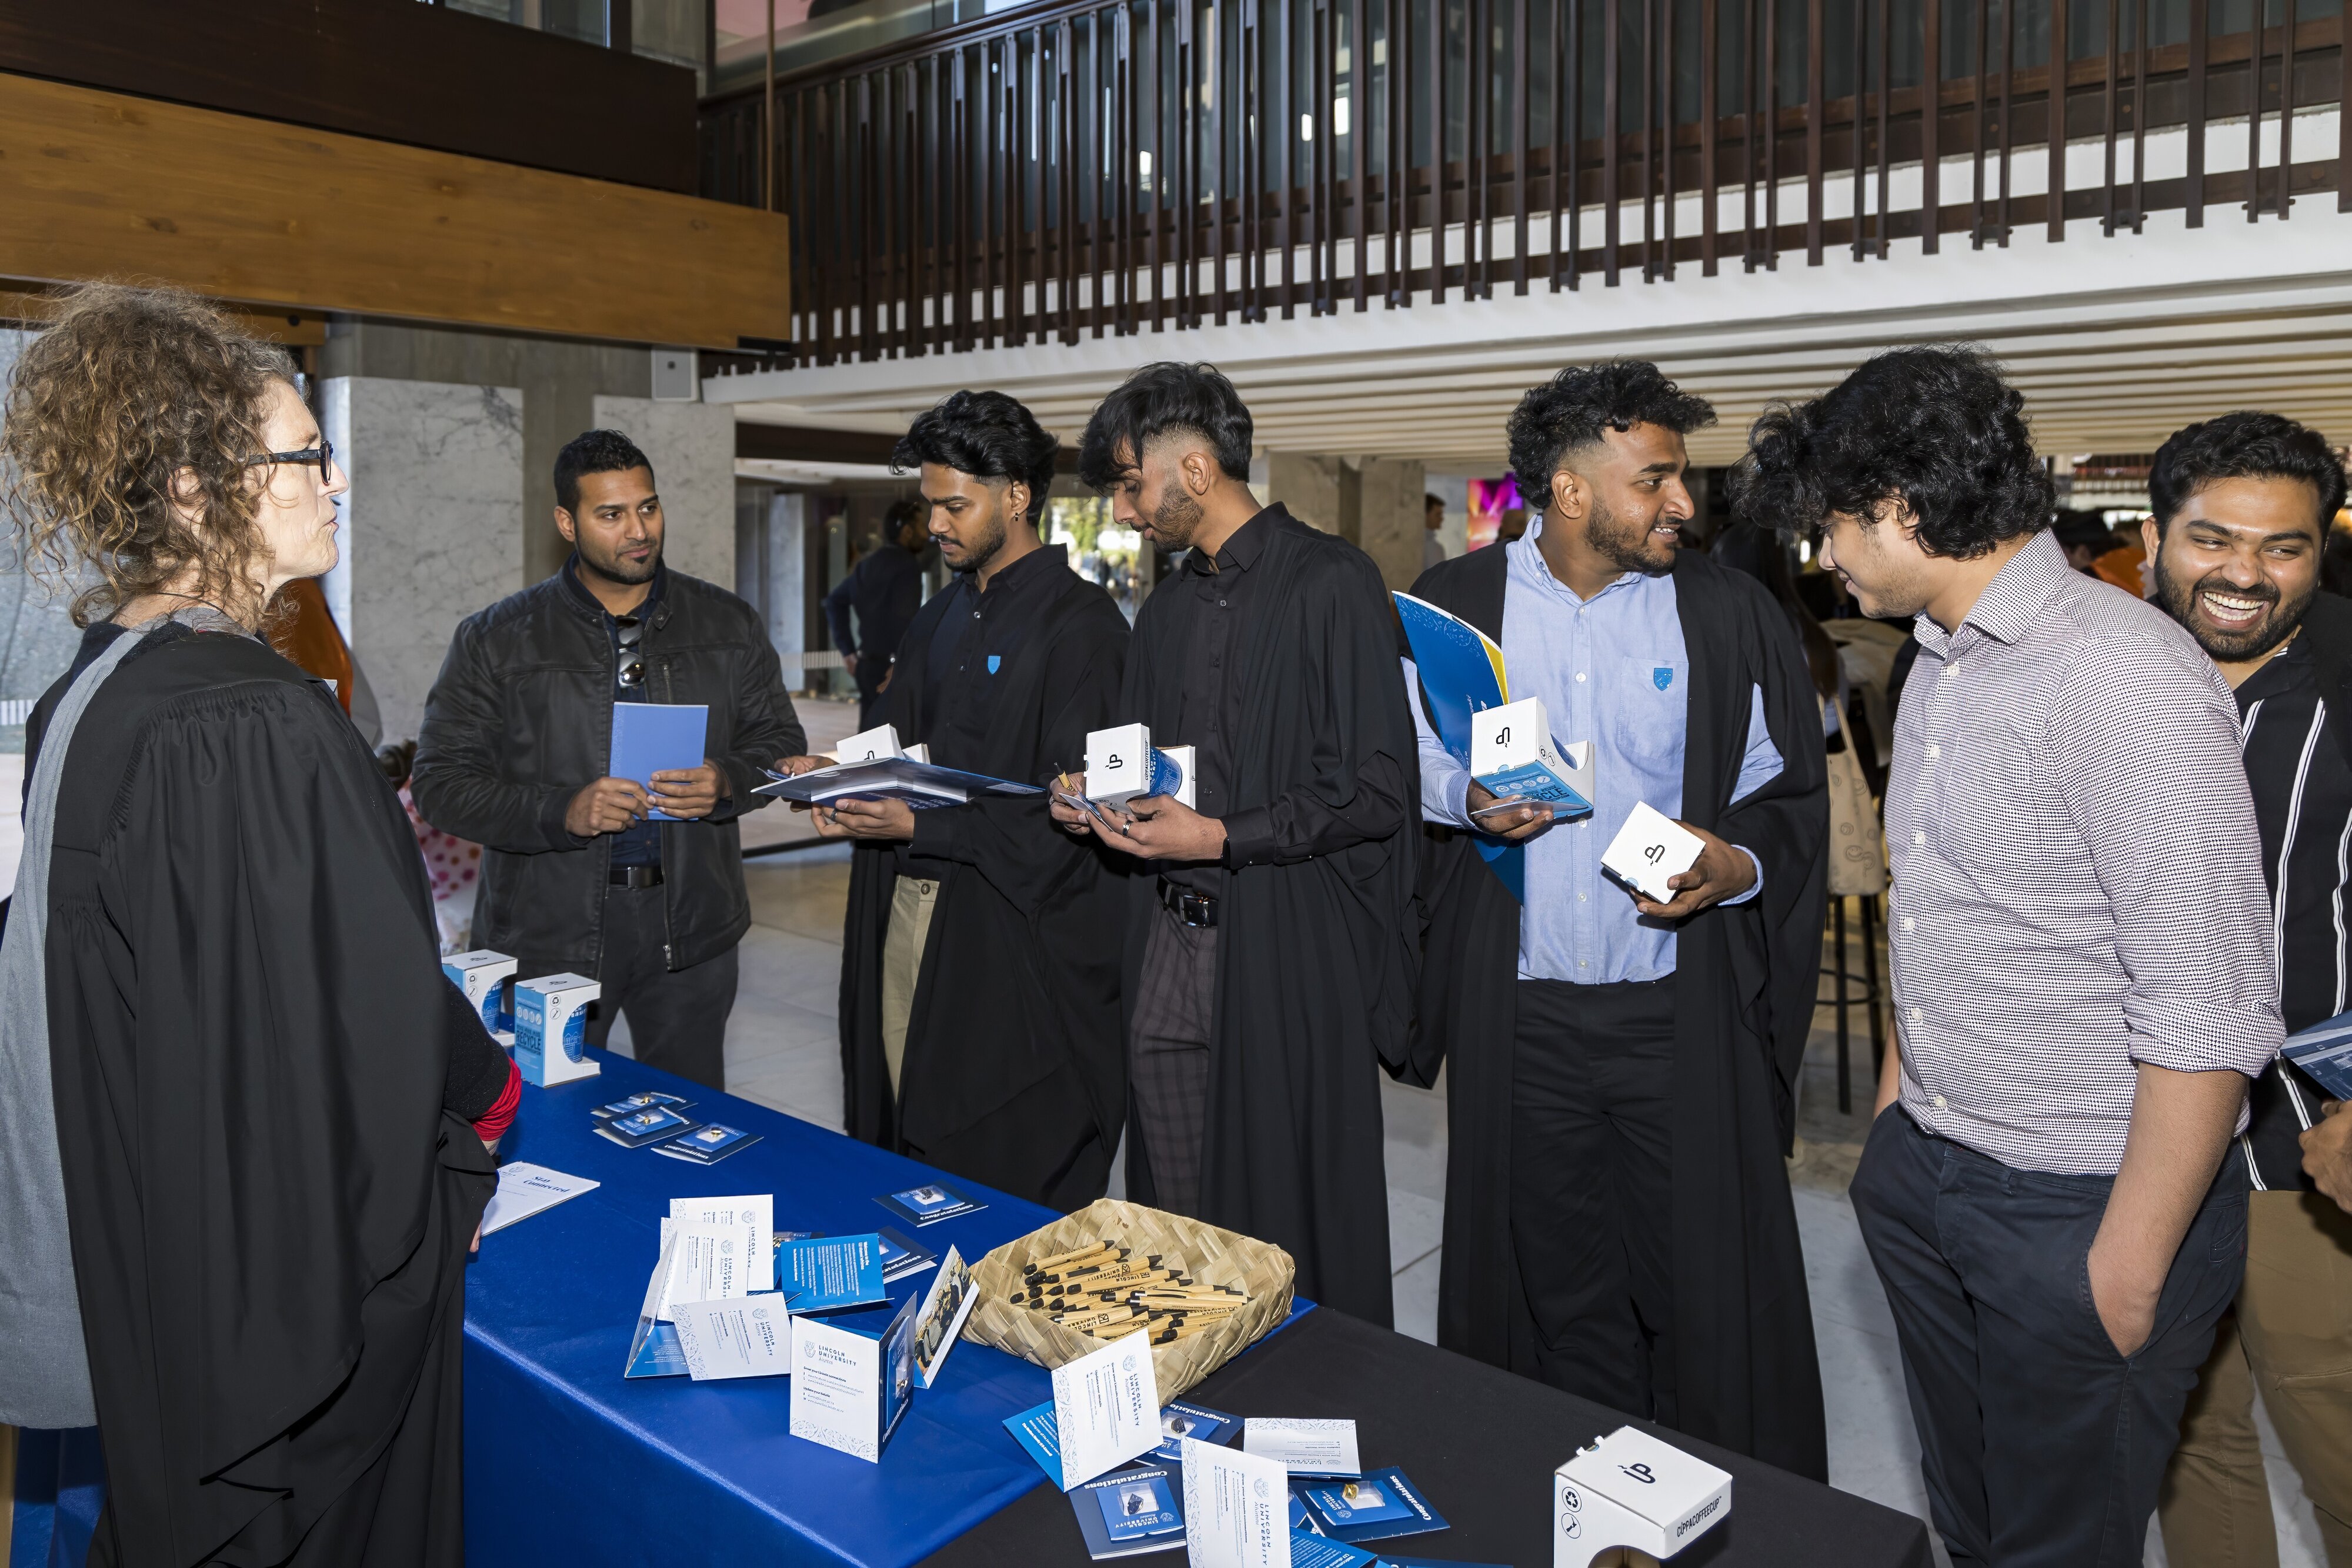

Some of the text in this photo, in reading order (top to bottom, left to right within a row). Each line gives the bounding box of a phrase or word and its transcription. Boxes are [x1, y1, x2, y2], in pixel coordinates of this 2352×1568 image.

[516, 1030, 541, 1051] RECYCLE
[523, 1180, 571, 1193] Connected
[765, 1322, 775, 1346] LINCOLN
[1075, 1321, 1097, 1331] LINCOL
[760, 1322, 773, 1356] UNIVERSITY
[819, 1345, 845, 1357] LINCOLN
[819, 1351, 857, 1366] UNIVERSITY
[1129, 1376, 1140, 1426] UNIVERSITY
[1133, 1373, 1142, 1409] LINCOLN
[1169, 1403, 1230, 1424] Congratulatio
[1083, 1470, 1167, 1490] Congratulations
[1389, 1475, 1432, 1520] Congratulations
[1259, 1503, 1267, 1566] UNIVERSITY
